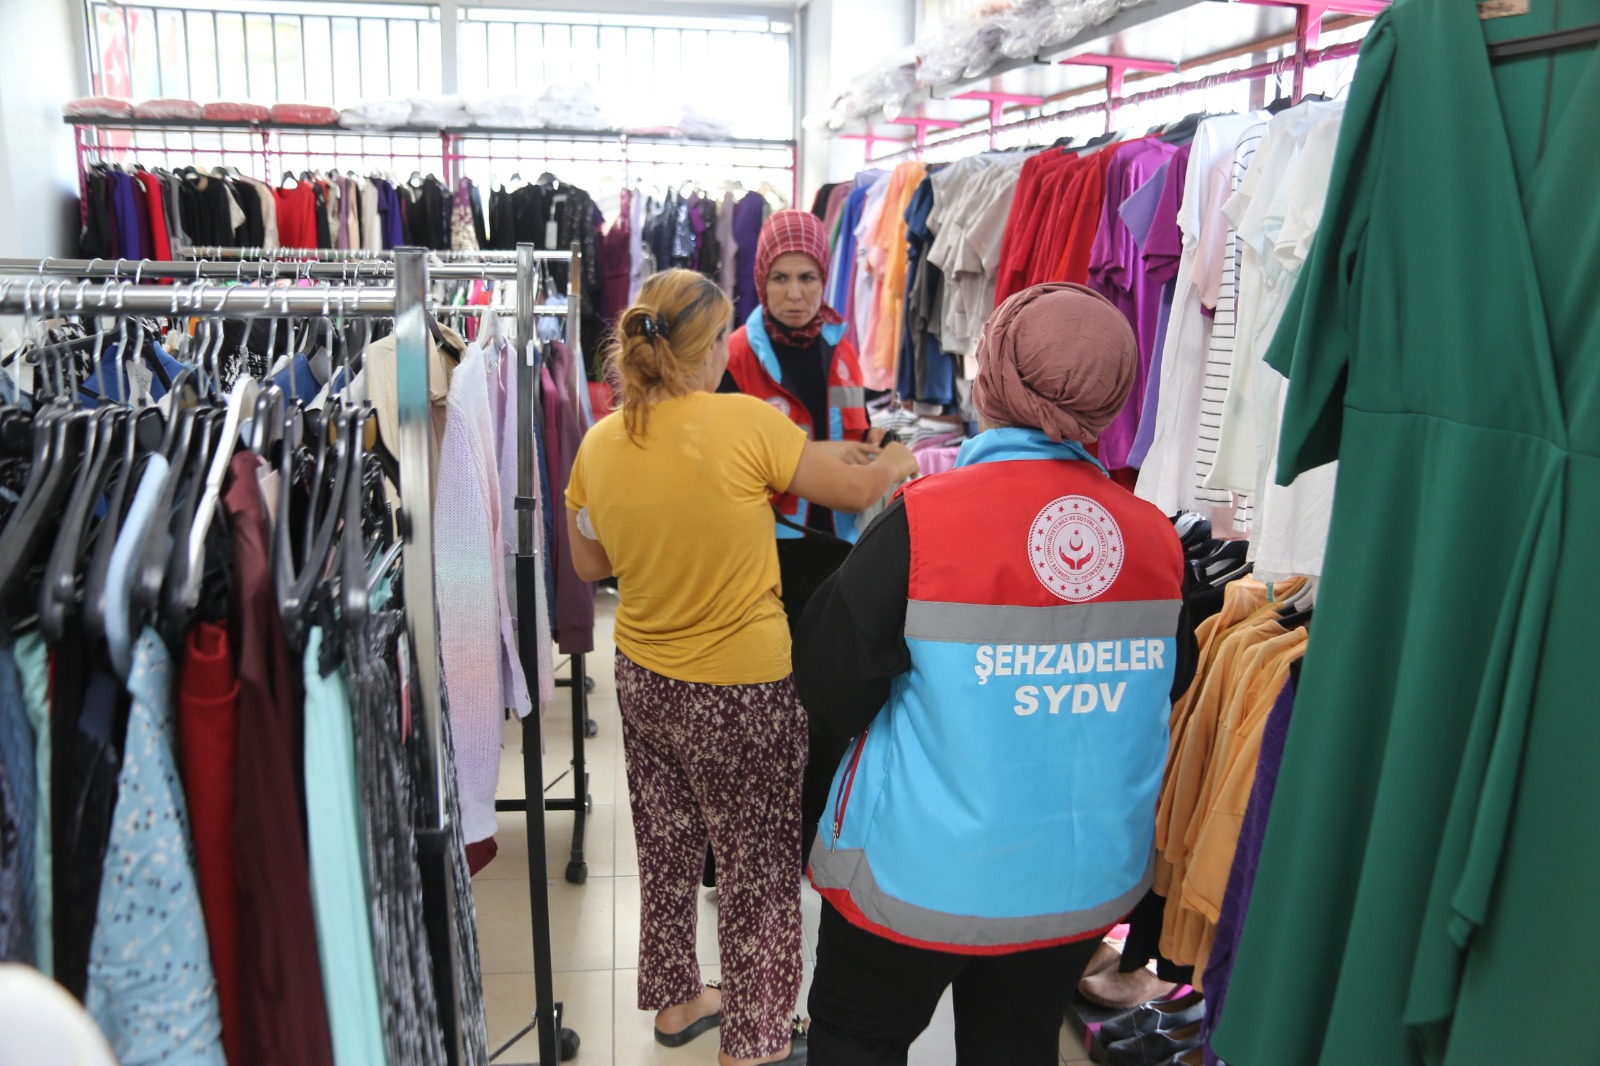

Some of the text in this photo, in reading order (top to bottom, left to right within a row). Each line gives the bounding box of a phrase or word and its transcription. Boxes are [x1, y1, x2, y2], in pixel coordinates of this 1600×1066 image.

[1077, 515, 1095, 528] SOSYAL
[974, 639, 1165, 685] ŞEHZADELER
[1013, 682, 1127, 716] SYDV
